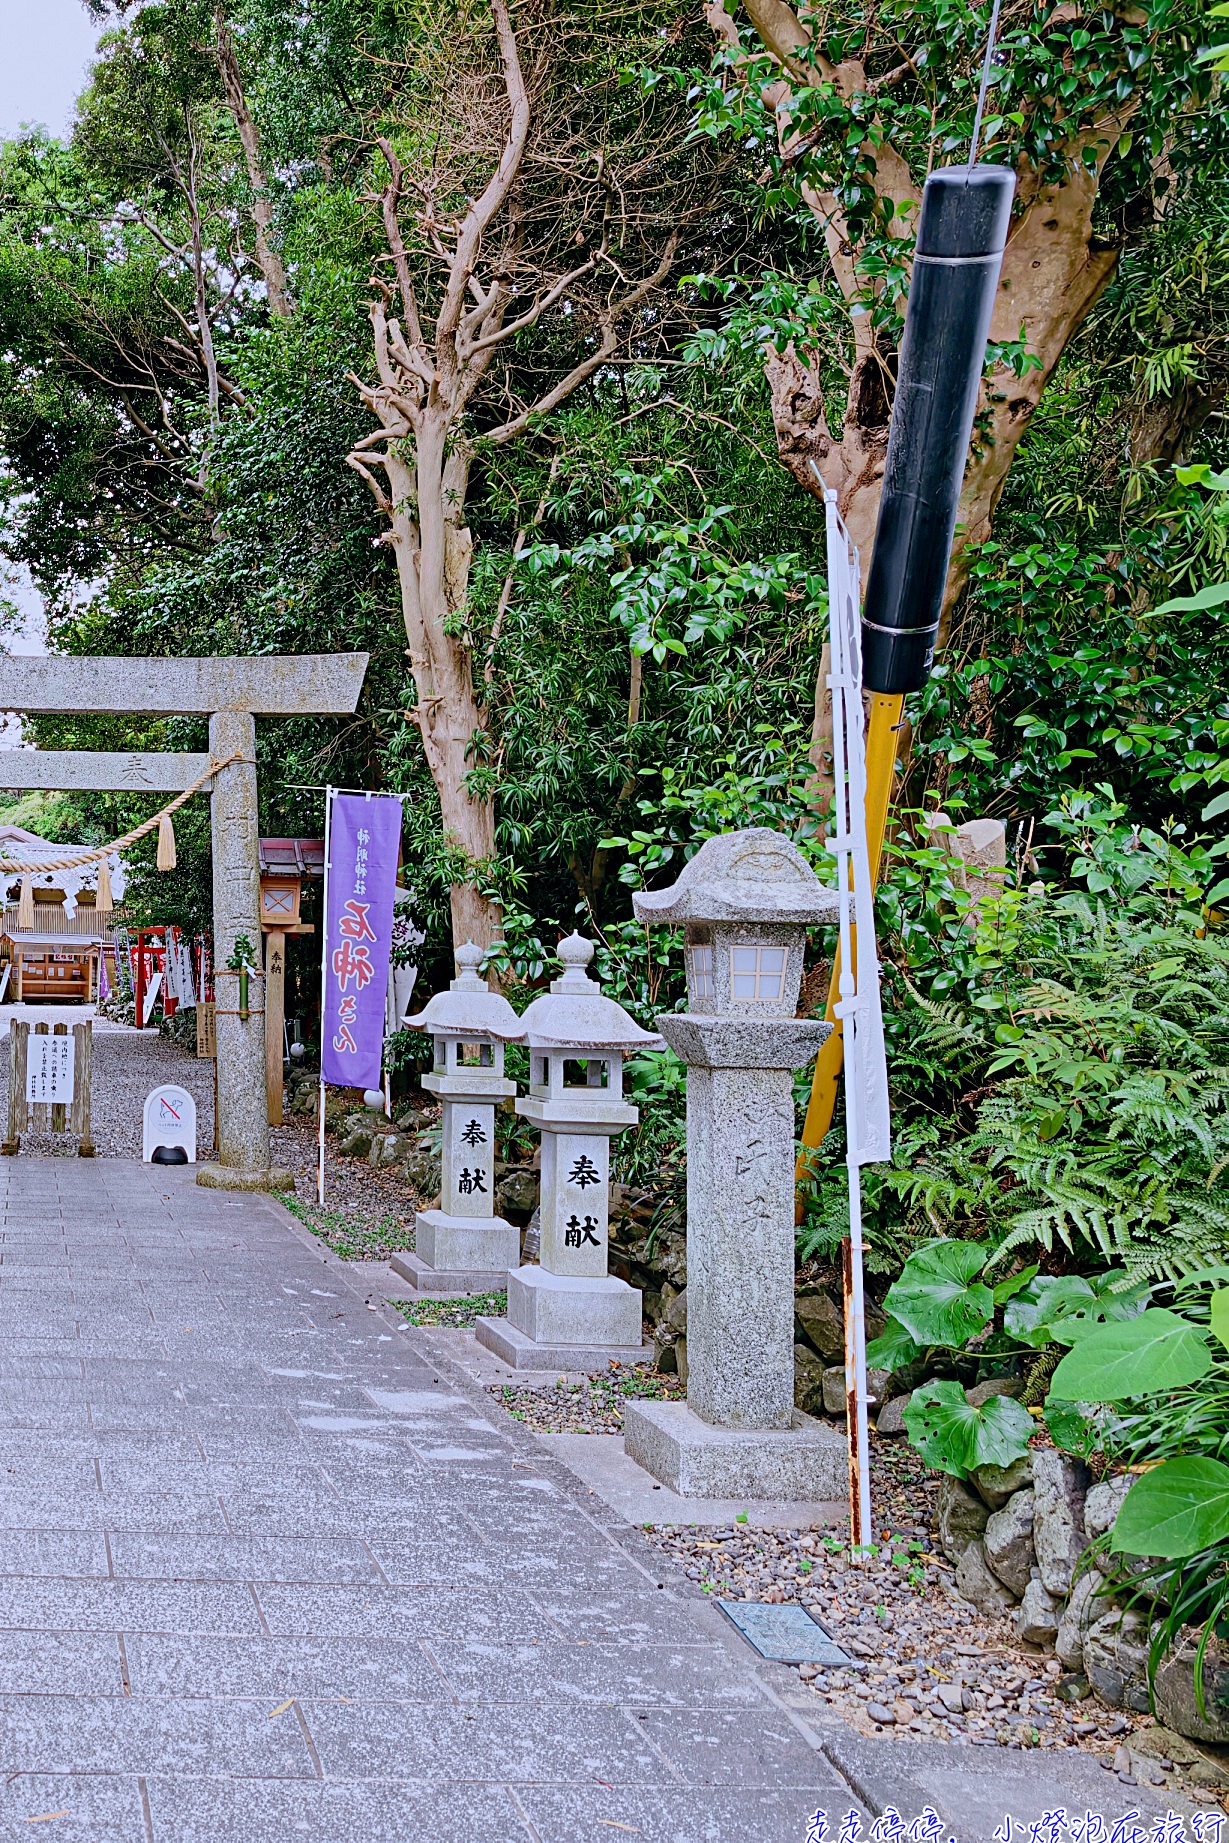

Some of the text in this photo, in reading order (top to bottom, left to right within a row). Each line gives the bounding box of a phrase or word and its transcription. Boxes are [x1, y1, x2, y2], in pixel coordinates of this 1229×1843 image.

[270, 950, 283, 975] 奉納
[458, 1119, 489, 1195] 奉献
[564, 1154, 602, 1249] 奉献
